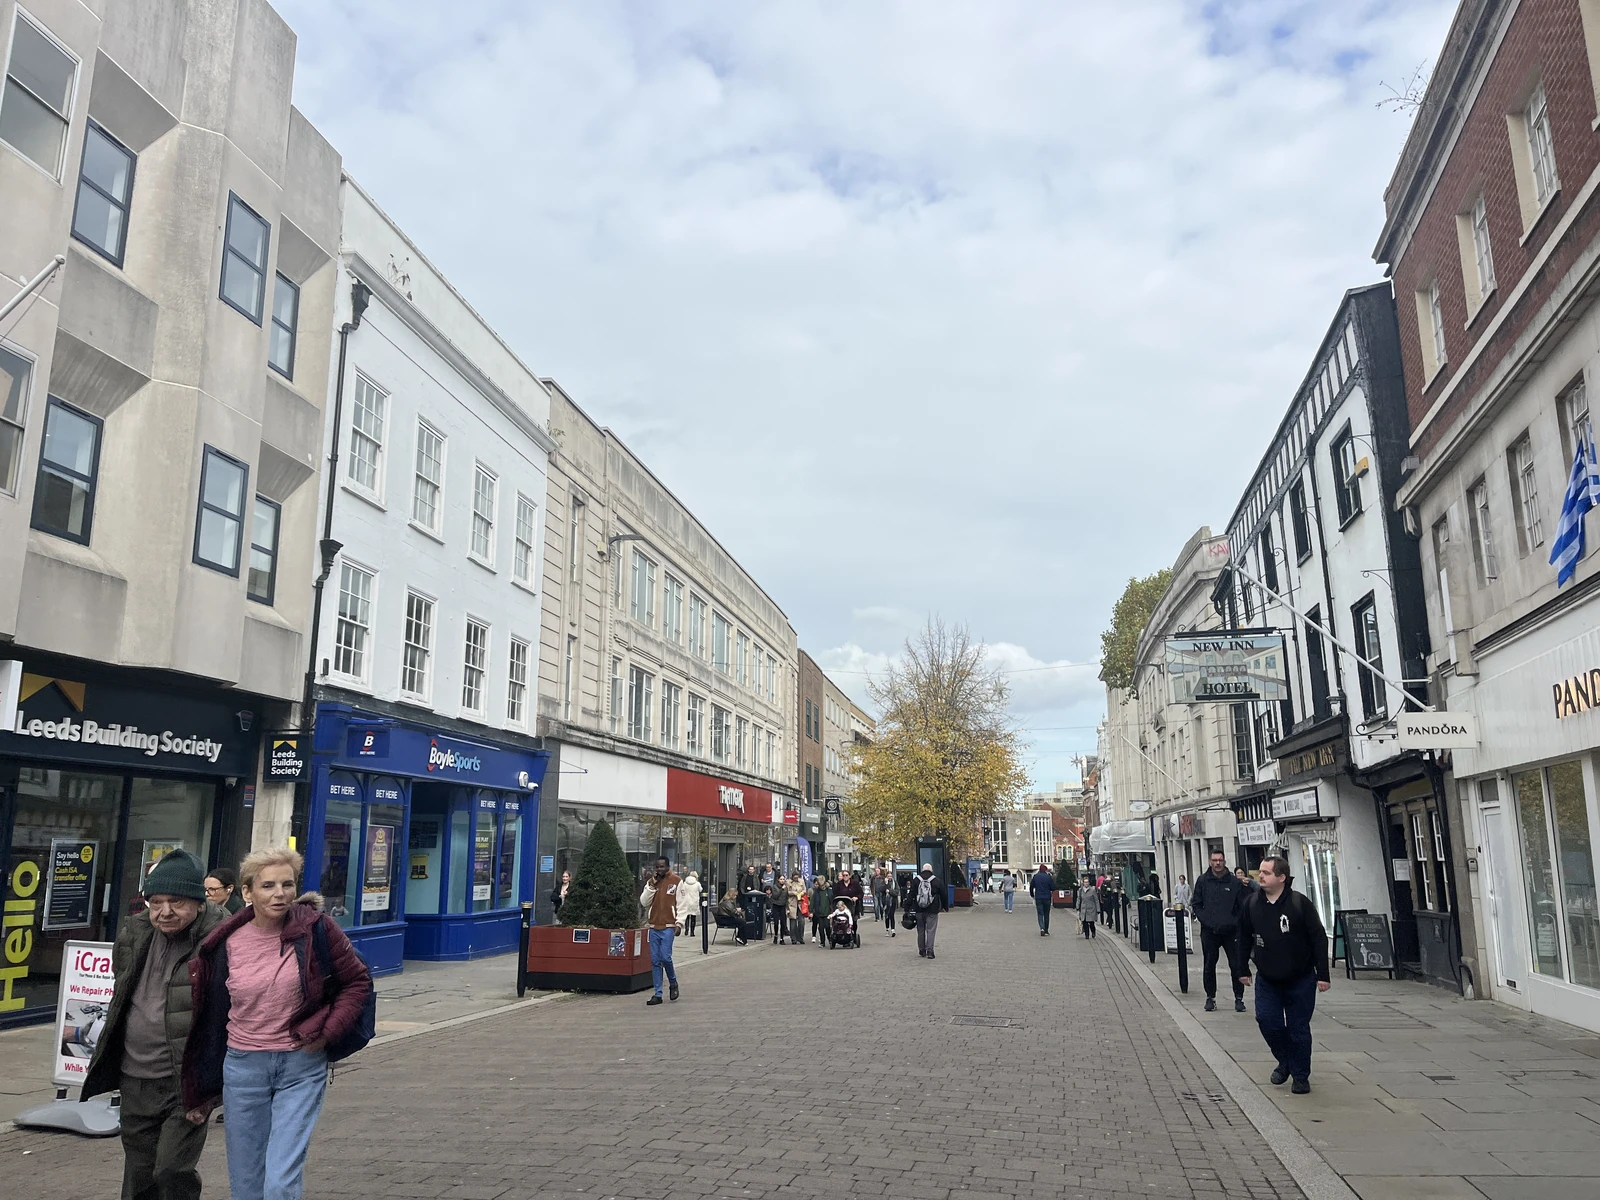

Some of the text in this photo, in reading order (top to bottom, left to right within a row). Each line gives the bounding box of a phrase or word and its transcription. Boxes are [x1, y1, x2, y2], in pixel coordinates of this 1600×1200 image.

[1192, 640, 1254, 653] NEW INN
[1202, 682, 1253, 695] HOTEL
[15, 710, 223, 762] Leeds Building Society
[364, 736, 374, 746] B
[272, 750, 296, 758] Leeds
[429, 747, 481, 772] BoyleSports
[272, 759, 303, 767] Building
[271, 767, 301, 776] Society
[330, 785, 355, 796] BET HERE
[376, 789, 398, 800] BET HERE
[487, 801, 496, 809] HERE
[56, 852, 66, 861] Say
[0, 860, 40, 1013] Hello
[75, 950, 114, 973] iCra
[70, 984, 80, 993] We
[81, 986, 103, 997] Repair
[64, 1063, 83, 1073] While
